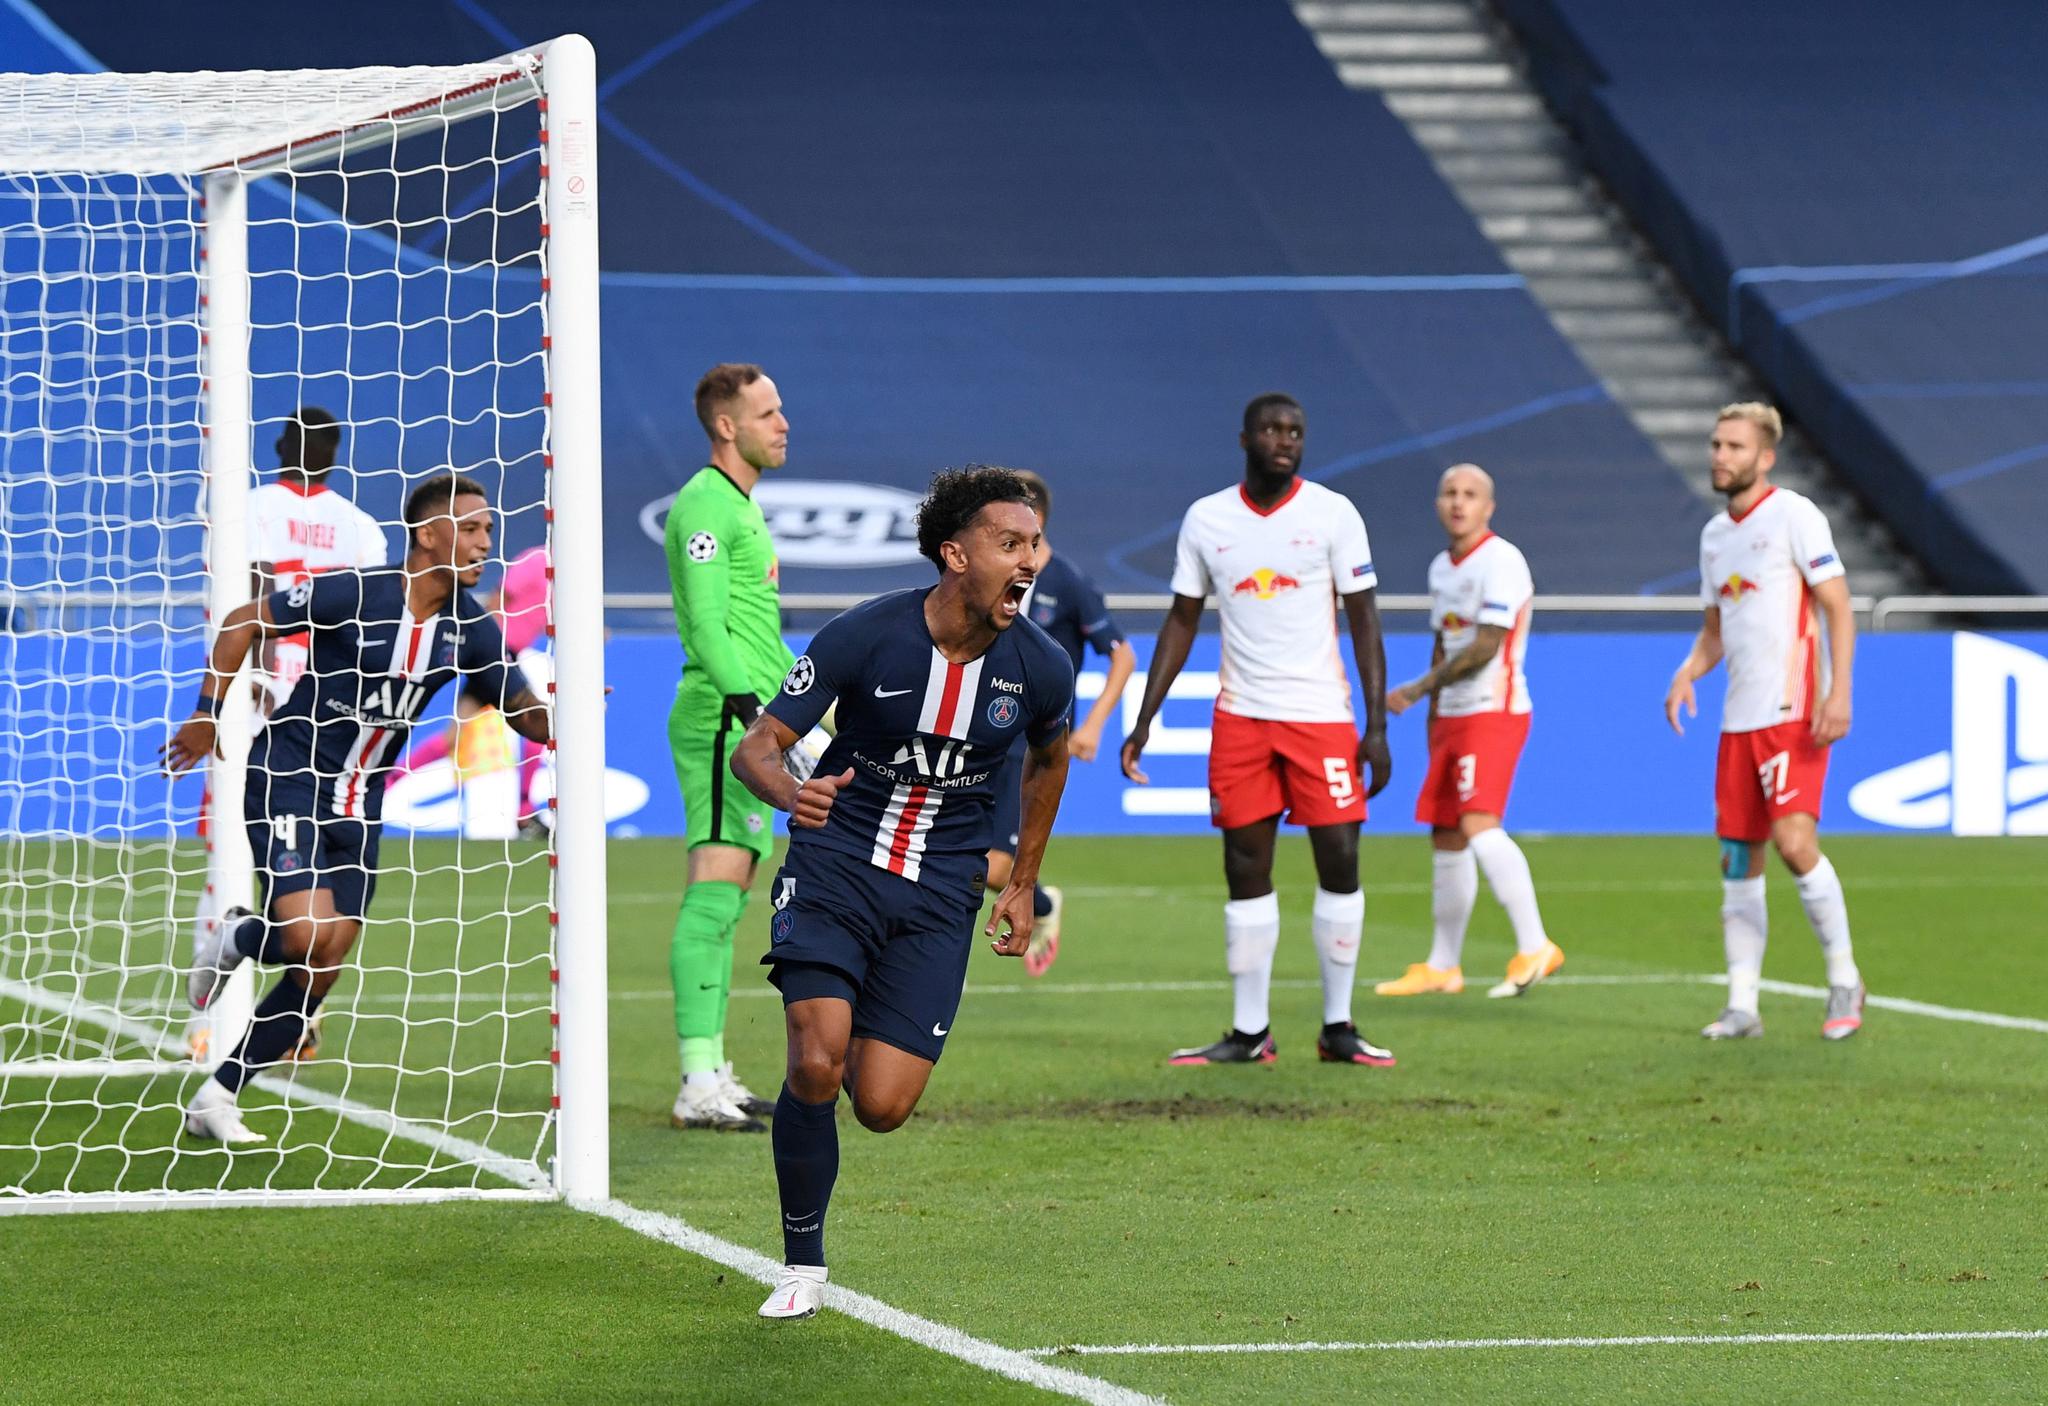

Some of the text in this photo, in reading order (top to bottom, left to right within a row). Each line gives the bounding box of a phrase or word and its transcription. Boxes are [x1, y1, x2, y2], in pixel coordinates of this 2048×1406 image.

[990, 676, 1023, 694] Merci
[852, 750, 896, 780] ACCOR
[899, 773, 930, 785] LIVE
[1322, 756, 1354, 799] 5
[1457, 752, 1478, 792] 3
[274, 813, 297, 851] 4
[785, 1222, 820, 1233] PARIS
